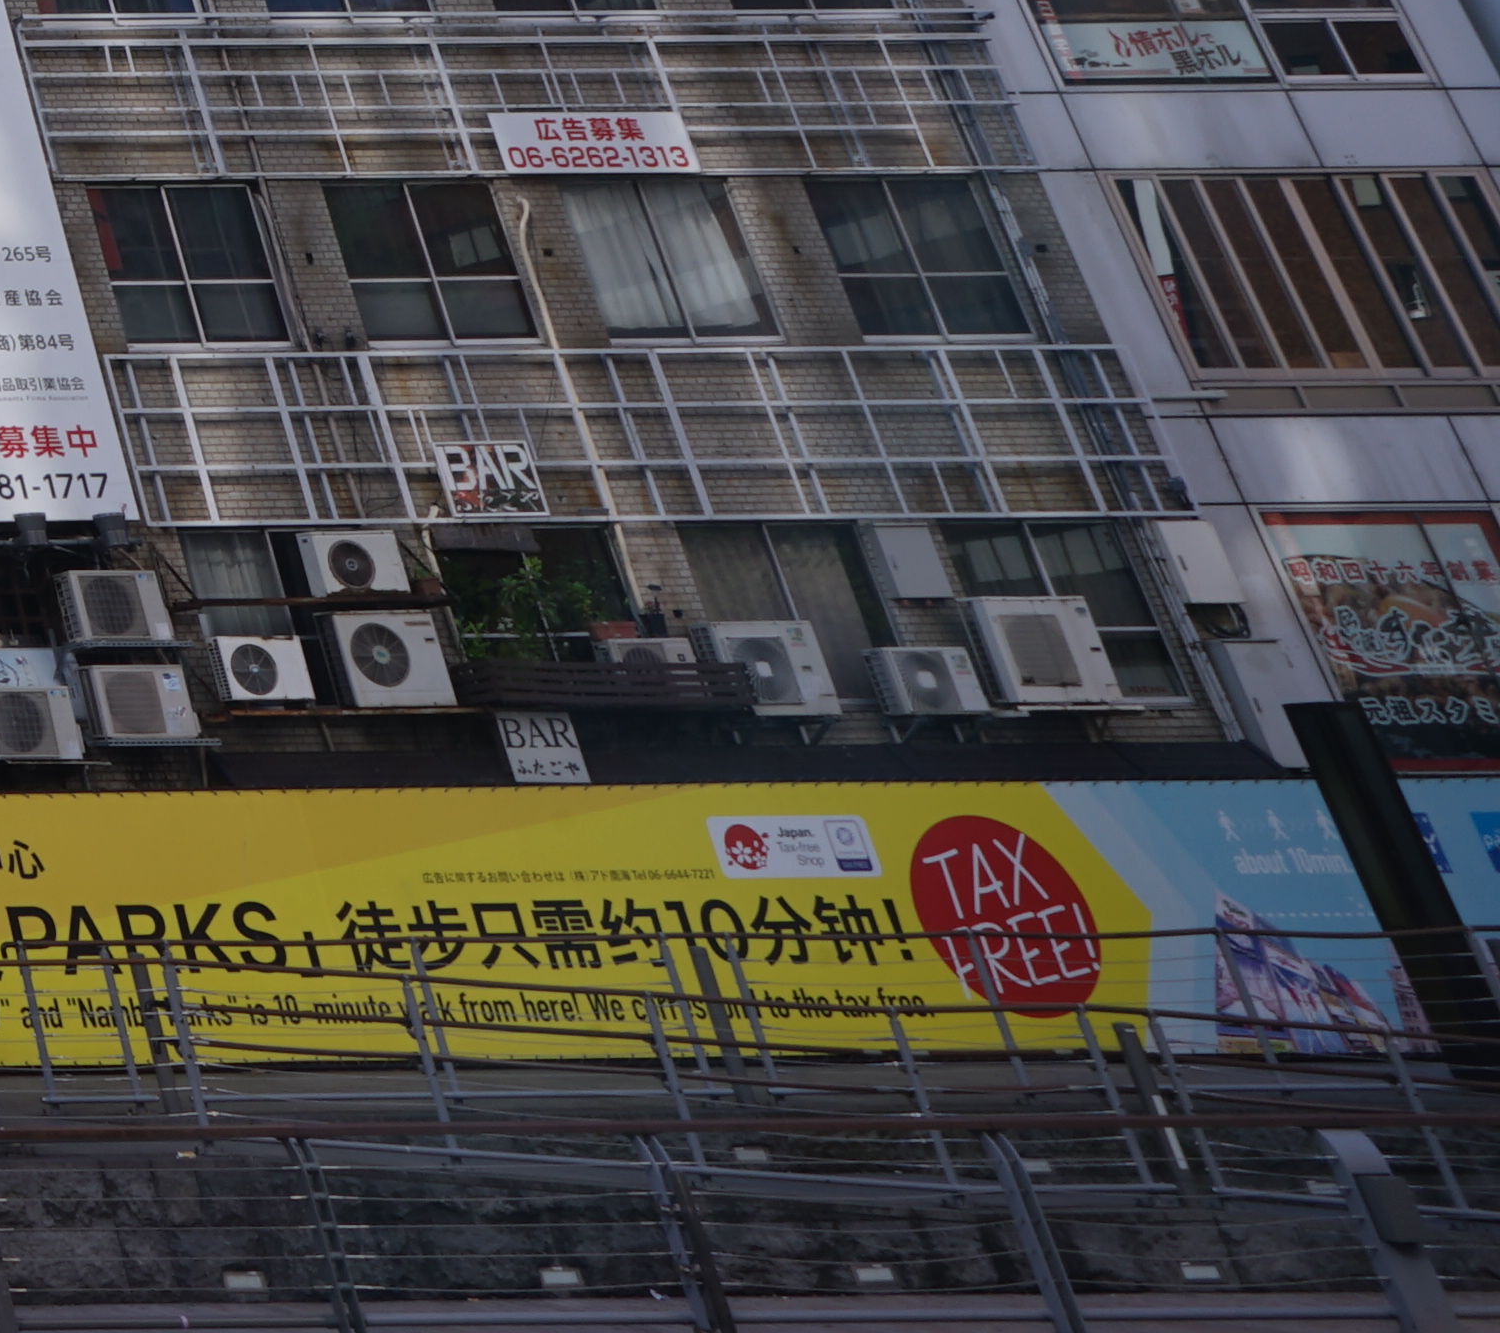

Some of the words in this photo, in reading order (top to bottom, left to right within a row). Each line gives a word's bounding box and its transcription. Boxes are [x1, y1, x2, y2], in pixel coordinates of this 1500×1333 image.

[535, 116, 645, 142] 広告募集
[508, 144, 689, 170] 06-6262-1313
[441, 444, 537, 491] BAR
[499, 717, 579, 750] BAR
[517, 759, 580, 777] ふたごや
[777, 826, 816, 840] Japan.
[796, 854, 826, 868] Shop
[1233, 847, 1291, 875] about
[922, 831, 1050, 921] TAX
[458, 992, 517, 1023] from
[522, 990, 582, 1023] here!
[588, 992, 626, 1022] We
